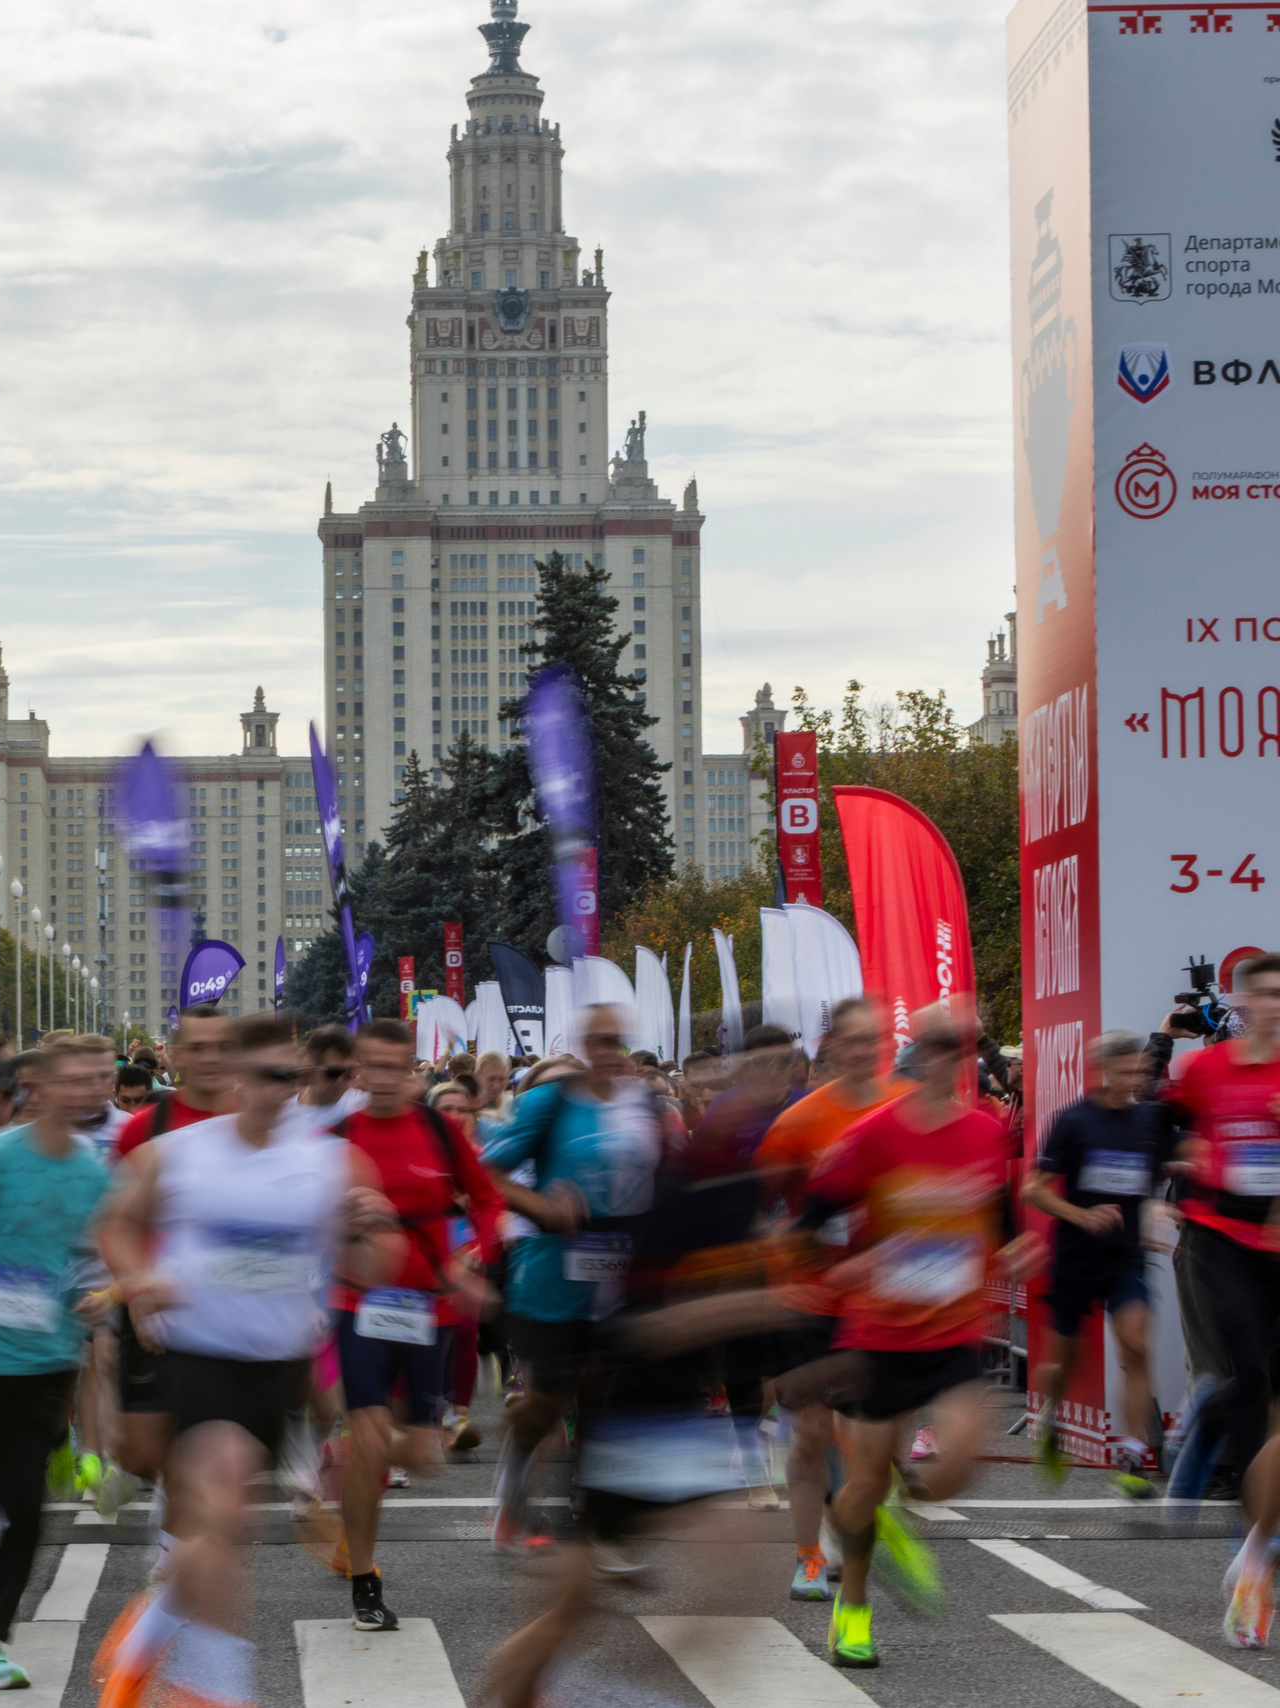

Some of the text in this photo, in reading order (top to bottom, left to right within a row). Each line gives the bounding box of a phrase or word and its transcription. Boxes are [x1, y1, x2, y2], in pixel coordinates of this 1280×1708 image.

[1184, 234, 1280, 254] Департам
[1185, 259, 1251, 276] спорта
[1185, 281, 1252, 298] города
[1192, 471, 1279, 481] ПОЛУМАРАФОН
[1192, 485, 1240, 500] МОЯ
[1234, 616, 1280, 642] ПО
[782, 787, 815, 795] КЛАСТЕР
[789, 804, 810, 828] B
[1169, 853, 1266, 894] 3-4
[189, 975, 226, 997] 0:49
